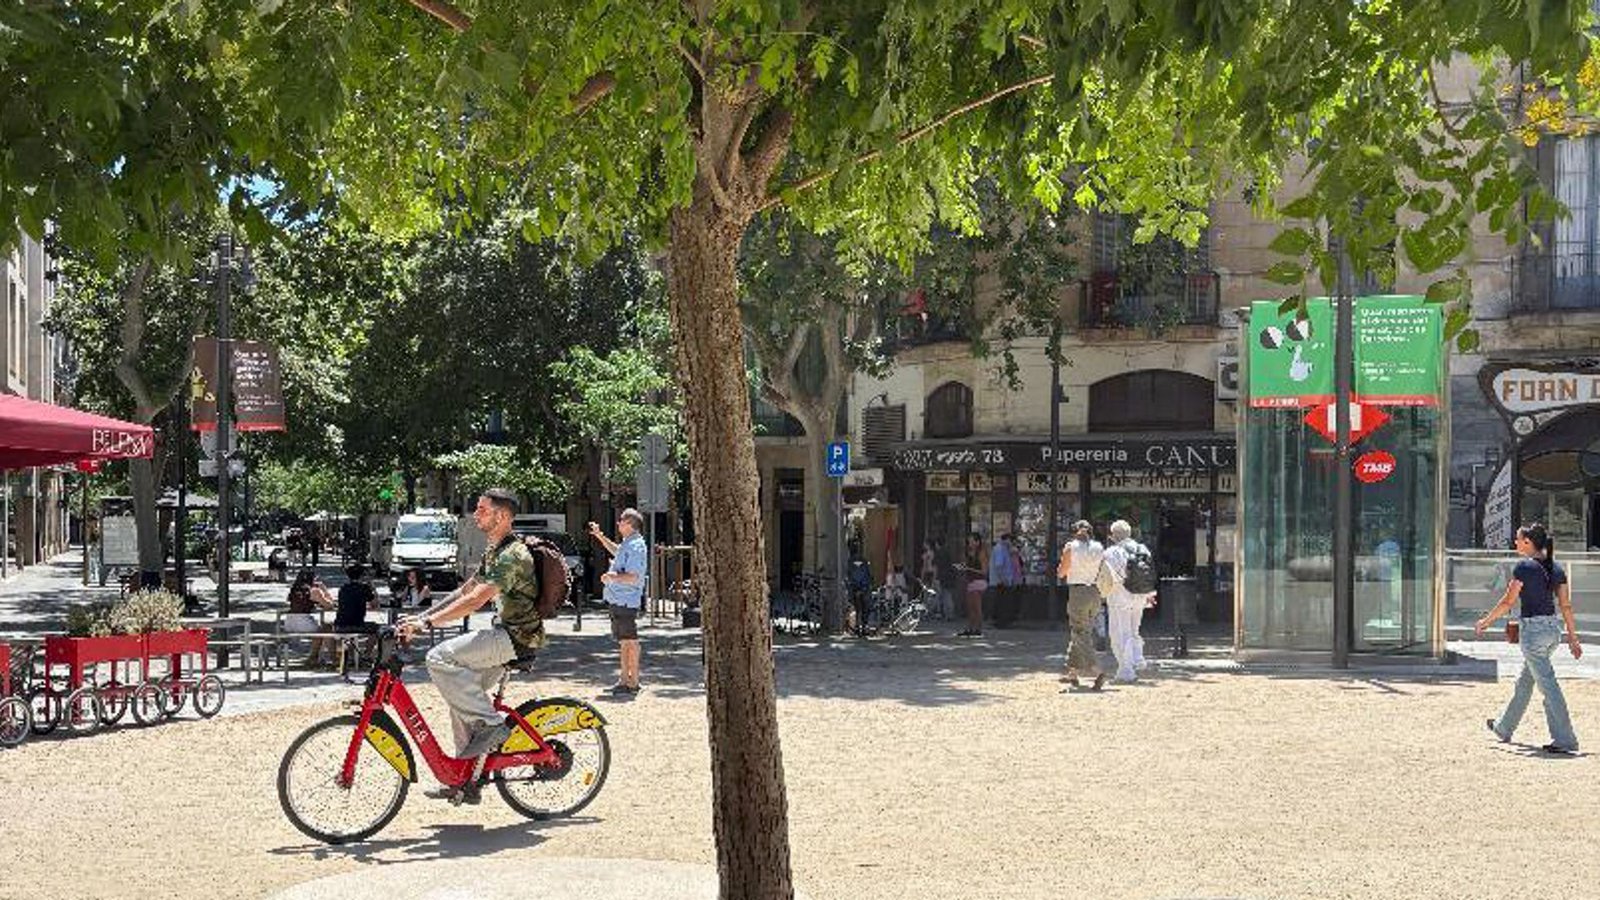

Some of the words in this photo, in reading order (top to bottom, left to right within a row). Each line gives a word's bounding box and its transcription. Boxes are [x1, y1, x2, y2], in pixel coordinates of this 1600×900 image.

[833, 445, 843, 459] P
[1145, 445, 1237, 467] CANU
[1362, 462, 1393, 474] TMB
